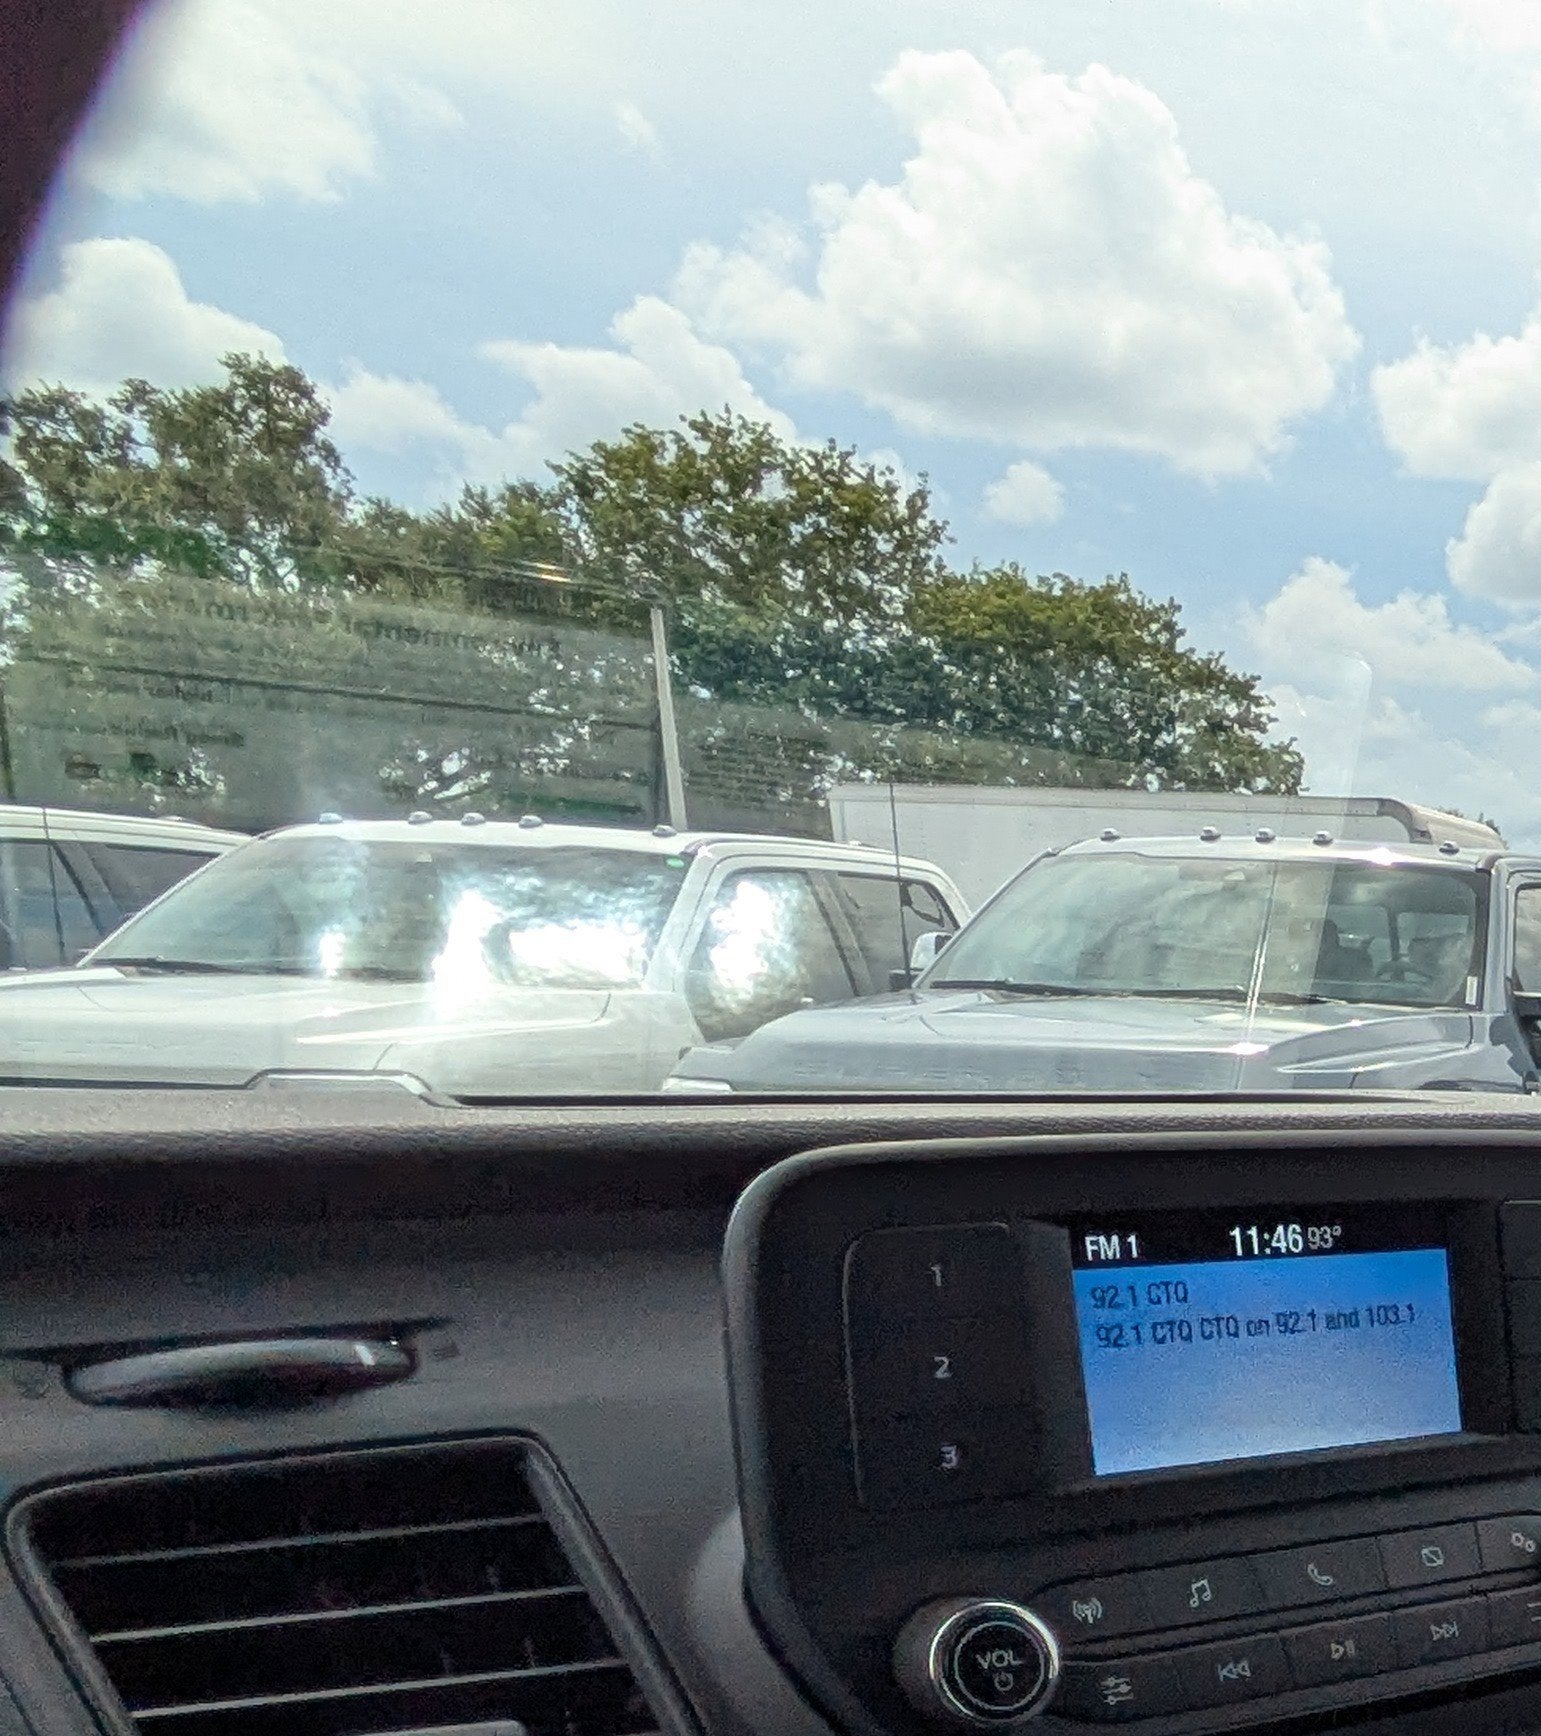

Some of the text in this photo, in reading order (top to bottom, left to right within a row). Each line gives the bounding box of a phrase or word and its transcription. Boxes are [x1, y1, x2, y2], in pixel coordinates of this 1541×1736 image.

[1085, 1233, 1138, 1261] FM 1
[1229, 1225, 1303, 1256] 11:46
[931, 1264, 942, 1287] 1
[1325, 1308, 1359, 1330] and
[934, 1356, 951, 1379] 2
[940, 1444, 958, 1469] 3
[975, 1649, 1022, 1669] VOL
